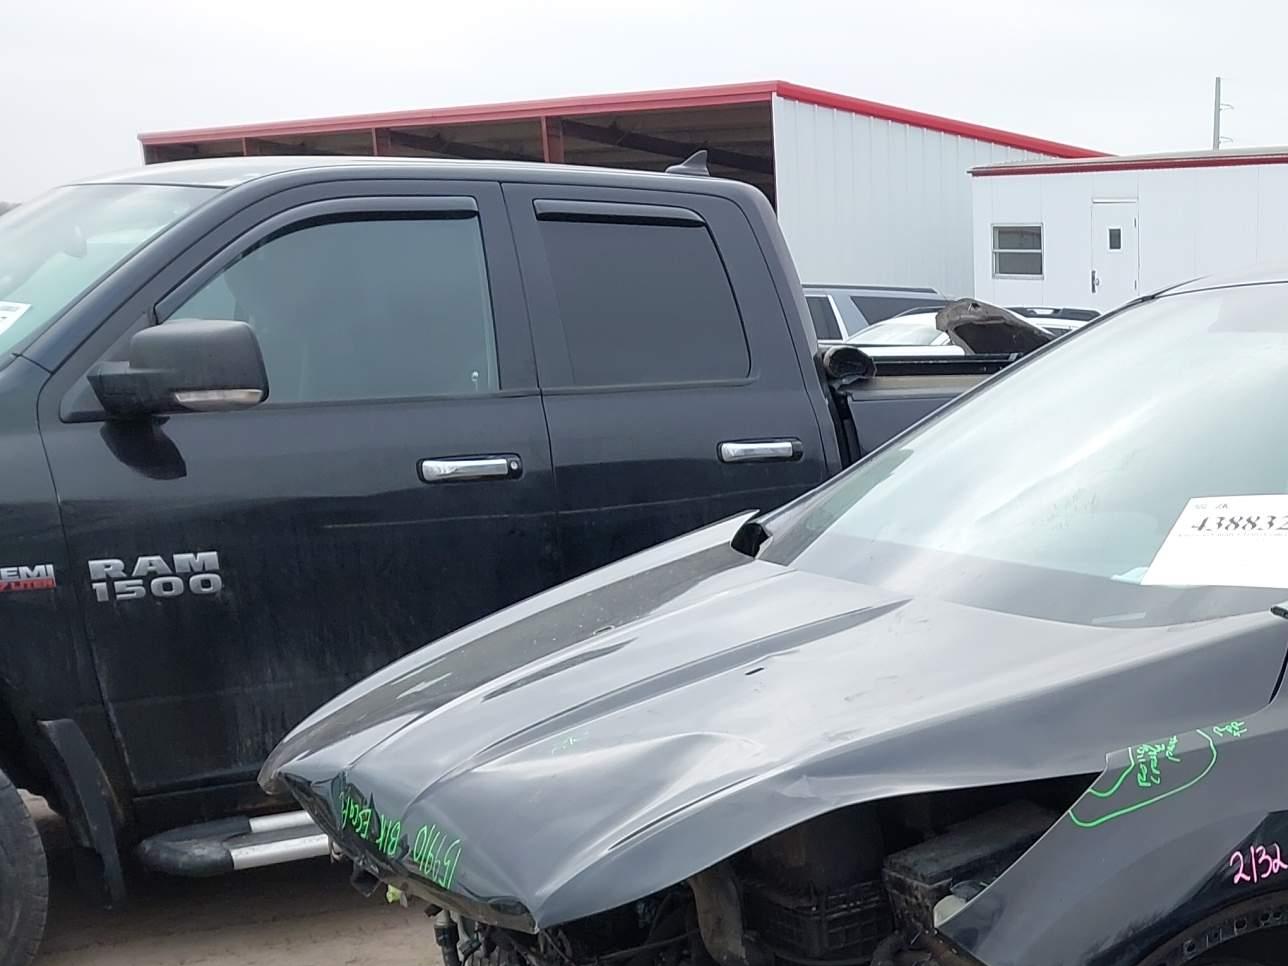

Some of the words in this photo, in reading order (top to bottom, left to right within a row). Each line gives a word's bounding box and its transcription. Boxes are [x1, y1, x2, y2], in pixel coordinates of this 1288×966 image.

[0, 564, 55, 582] EMI
[88, 551, 220, 580] RAM
[92, 573, 223, 602] 1500
